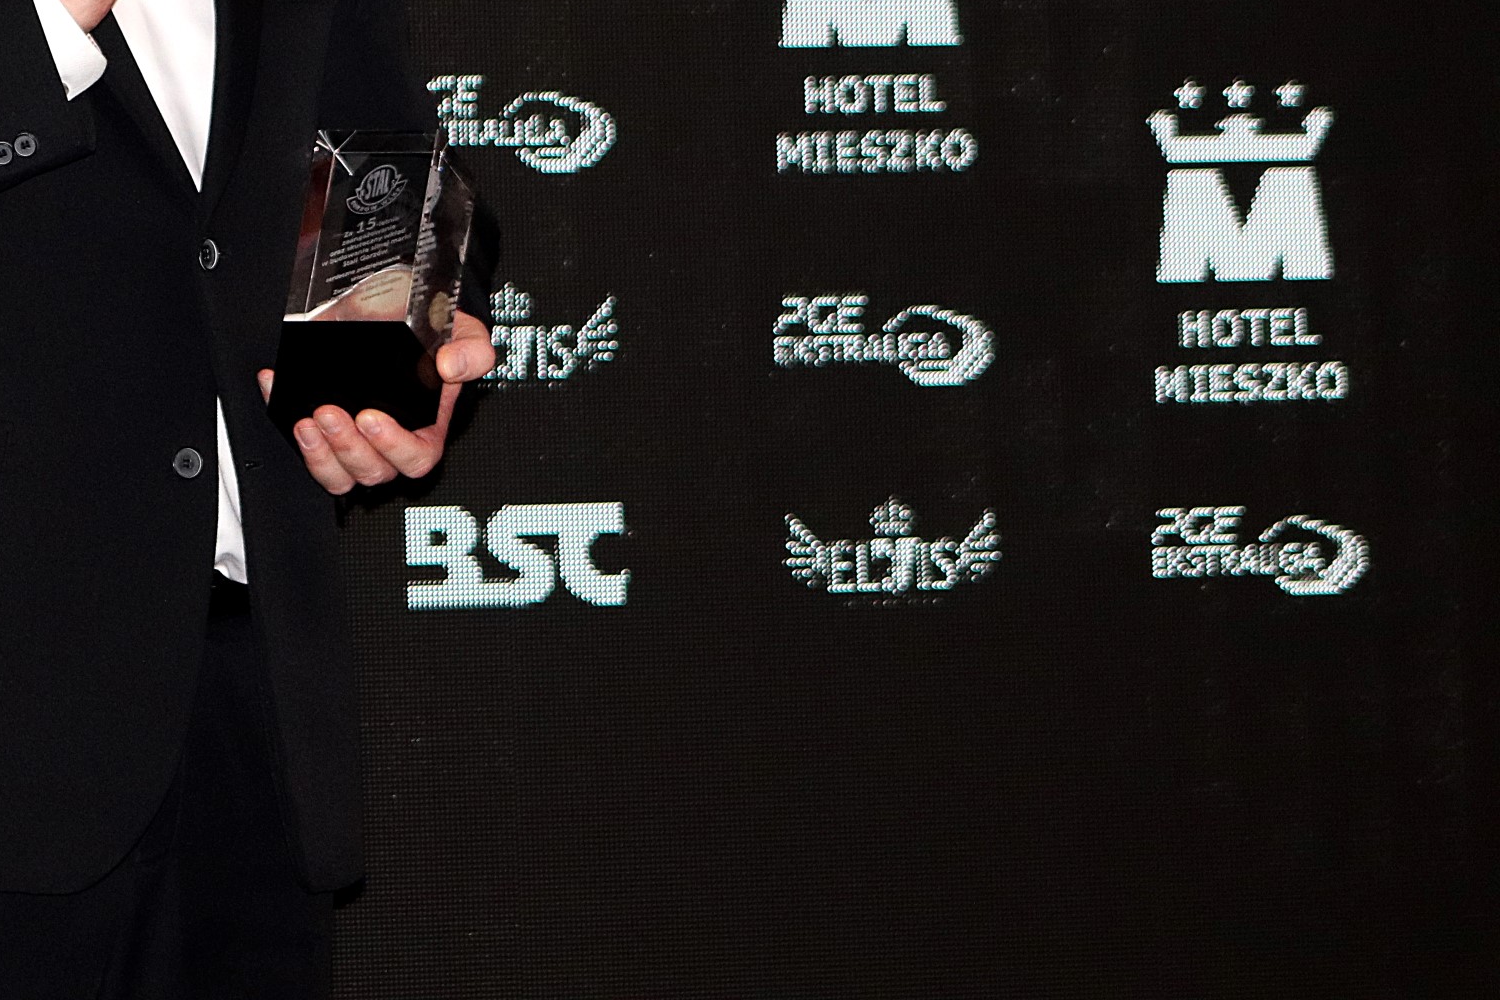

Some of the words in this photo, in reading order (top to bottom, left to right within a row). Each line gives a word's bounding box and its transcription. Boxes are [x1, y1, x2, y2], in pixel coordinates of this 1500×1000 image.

[803, 73, 945, 114] HOTEL
[775, 128, 976, 173] MIESZKO
[1181, 307, 1321, 348] HOTEL
[1154, 361, 1349, 403] MIESZKO
[405, 501, 631, 609] BSC
